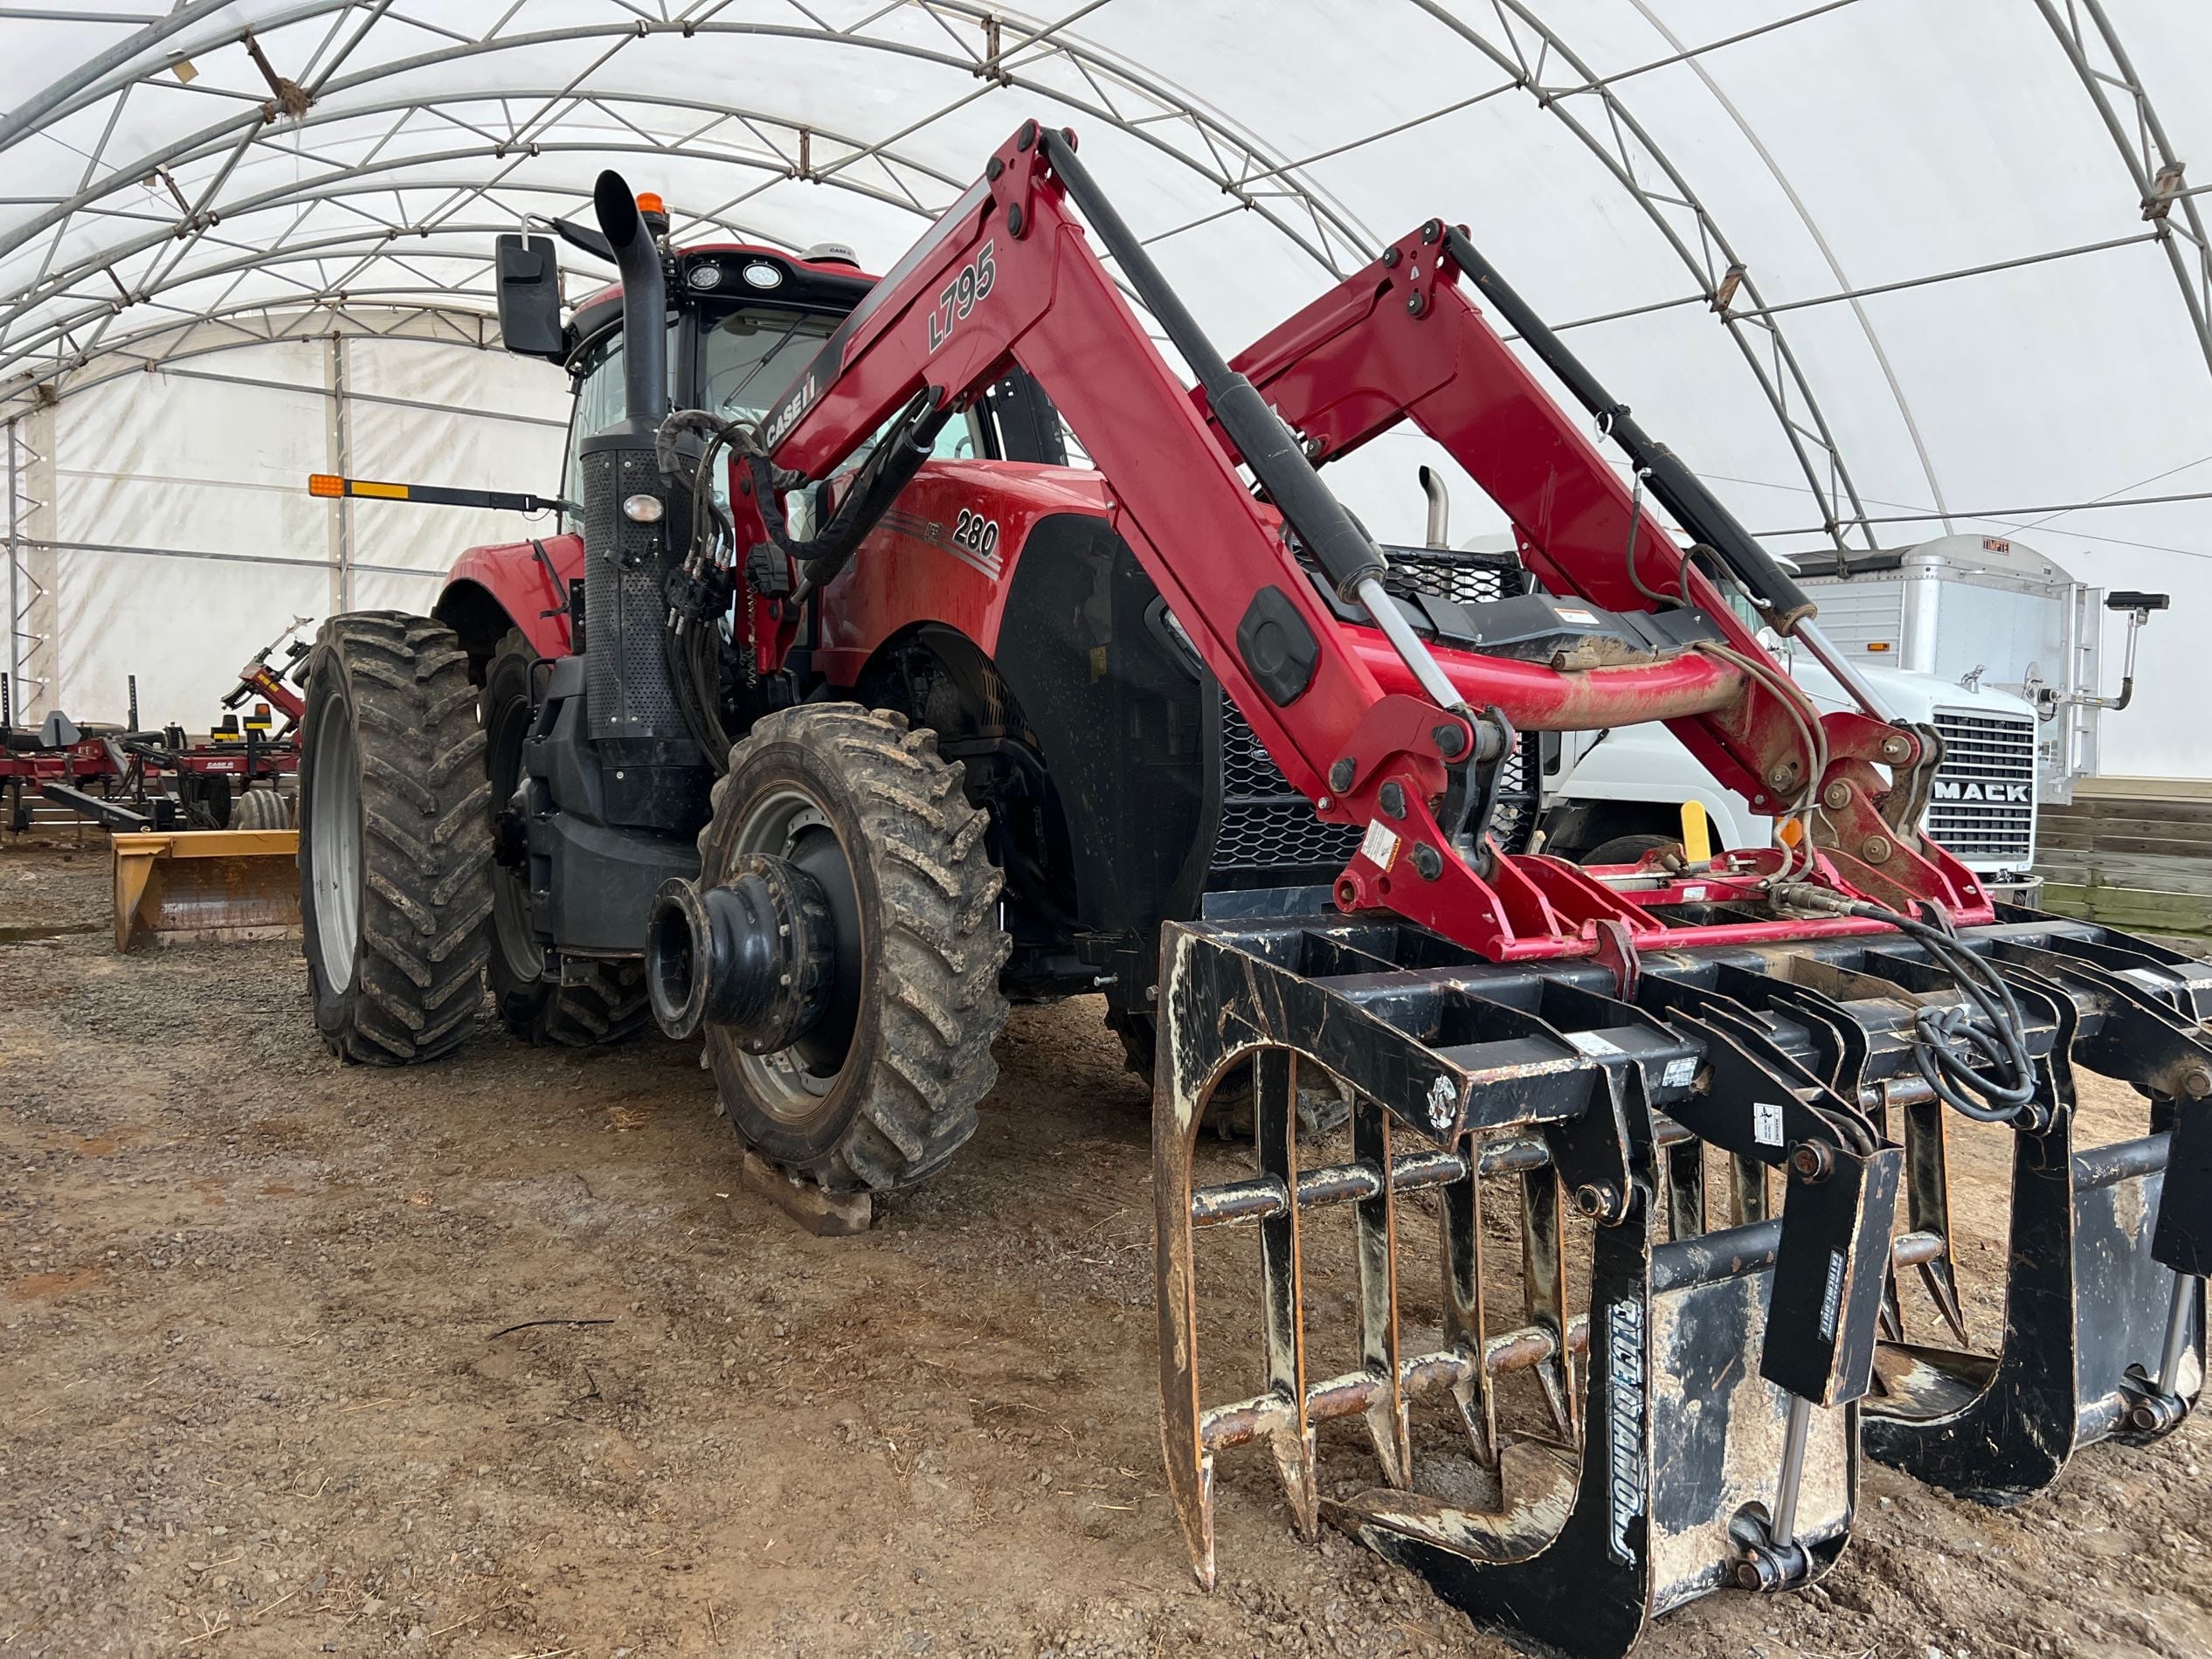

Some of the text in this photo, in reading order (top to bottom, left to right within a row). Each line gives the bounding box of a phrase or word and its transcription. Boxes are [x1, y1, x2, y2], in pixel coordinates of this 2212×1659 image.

[929, 238, 996, 356] L795
[766, 391, 802, 448] CASE
[952, 508, 999, 560] 280
[1982, 537, 2009, 554] TIMPTE
[1934, 781, 2029, 802] MACK
[1819, 1251, 1842, 1339] EXTREME DUTY
